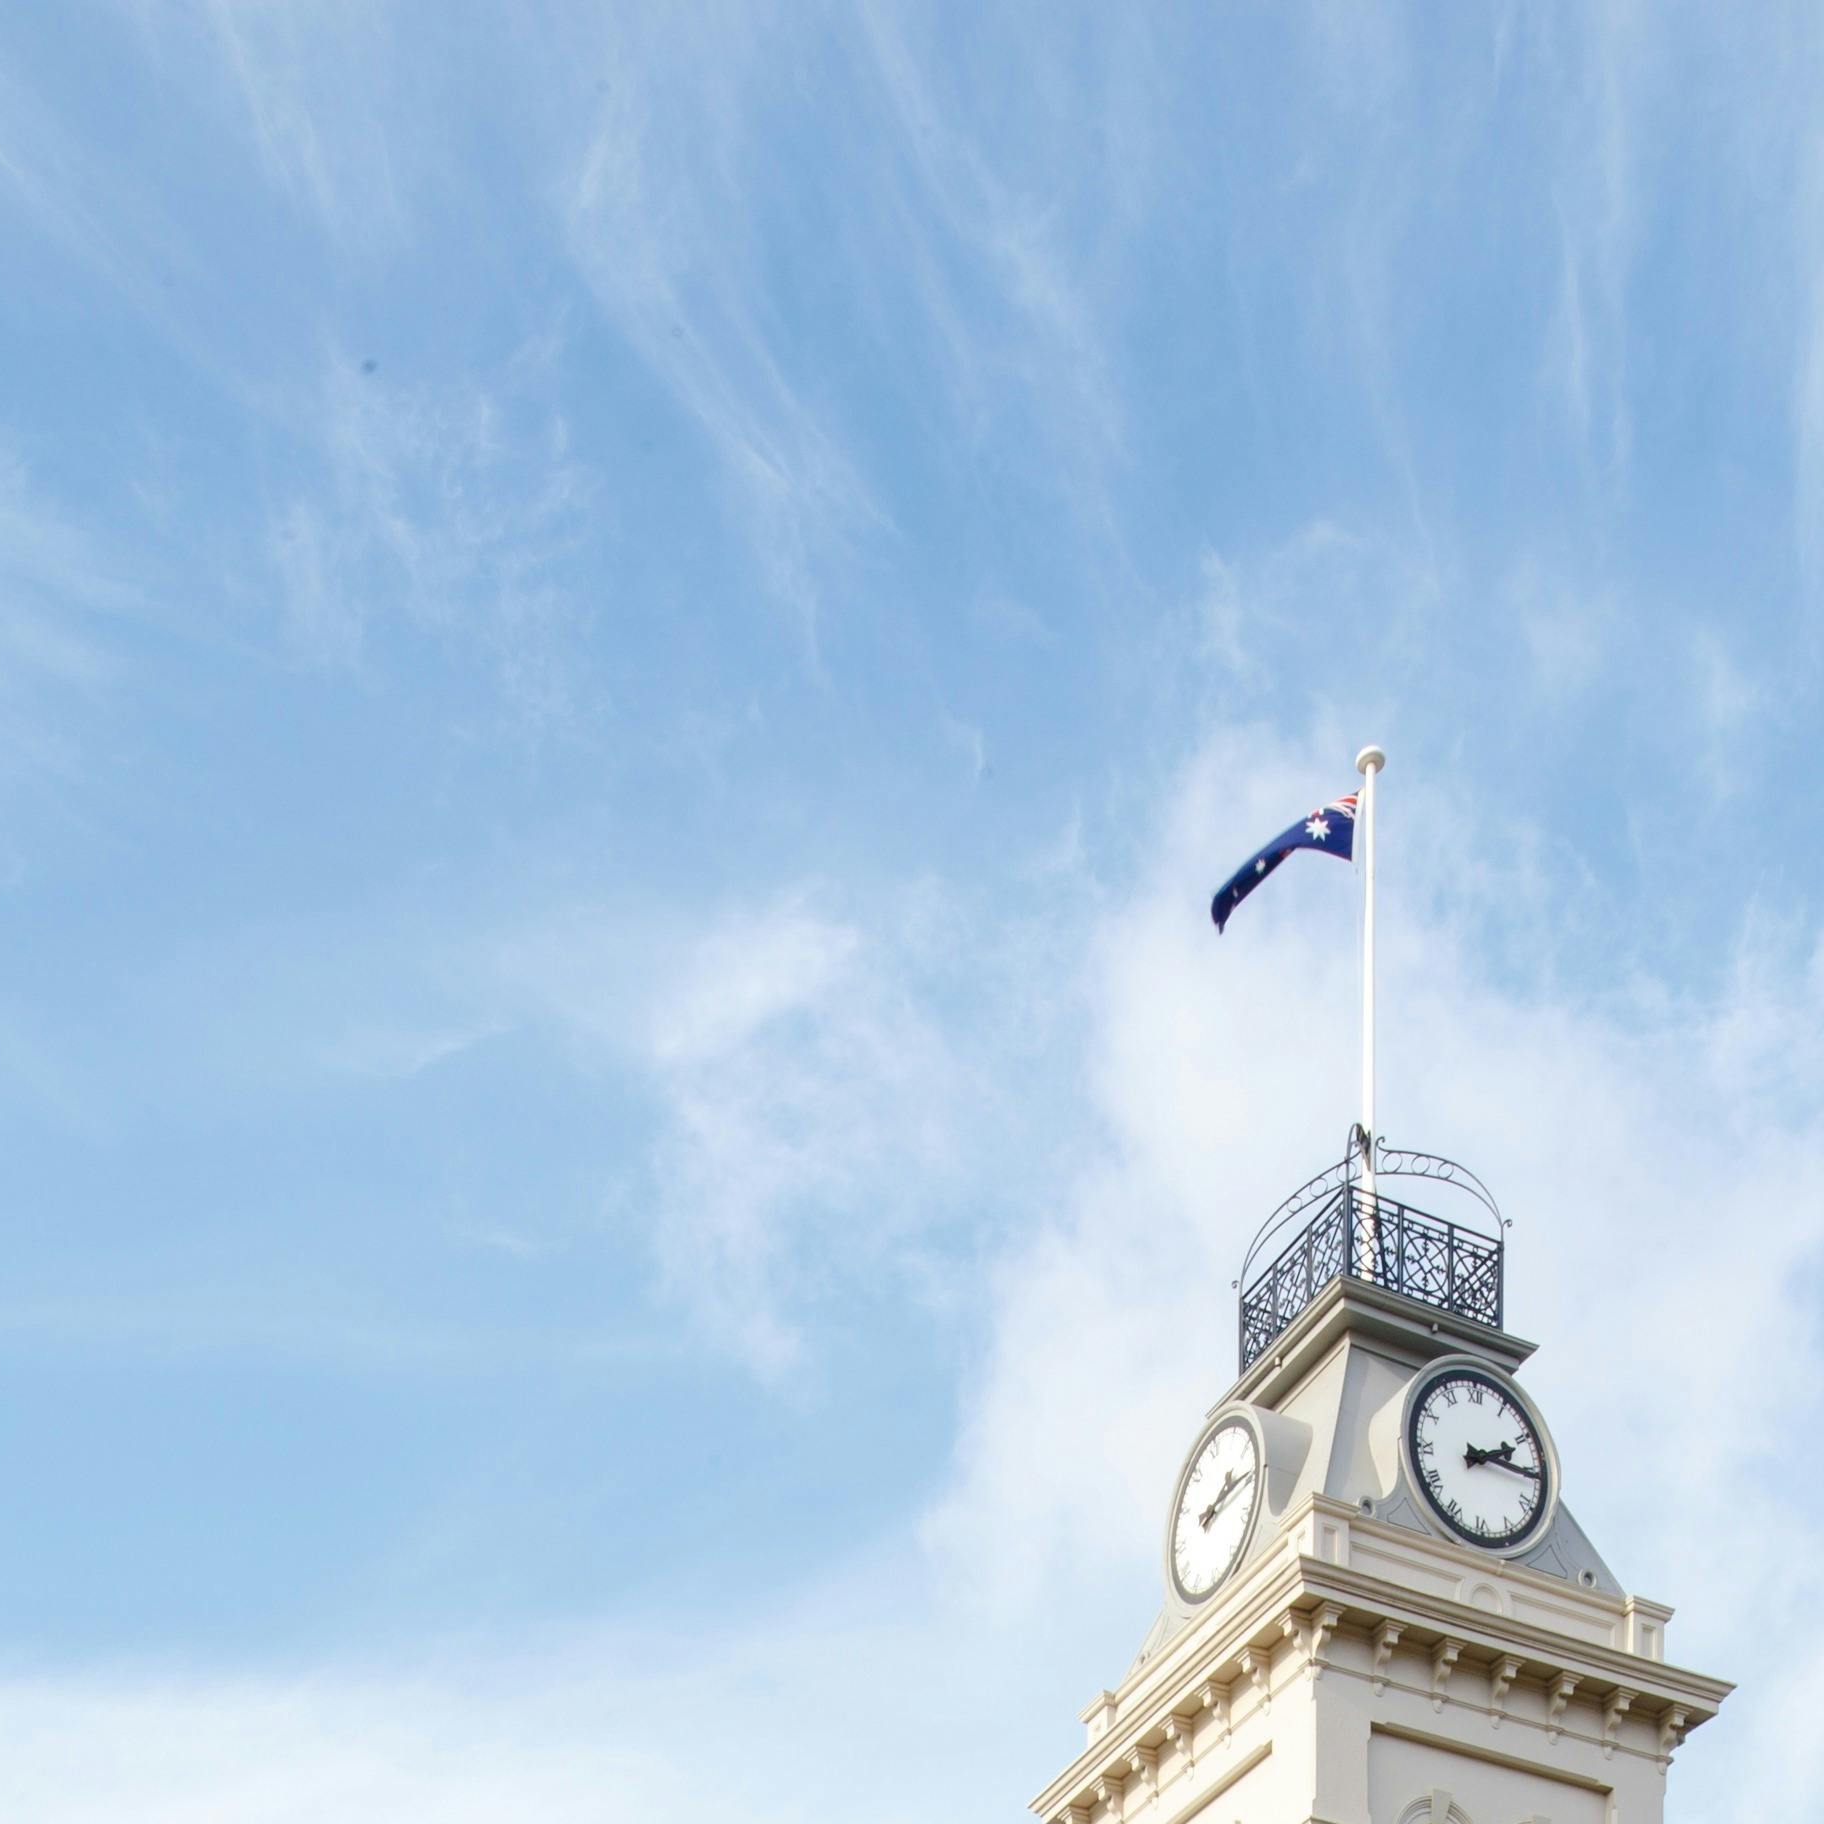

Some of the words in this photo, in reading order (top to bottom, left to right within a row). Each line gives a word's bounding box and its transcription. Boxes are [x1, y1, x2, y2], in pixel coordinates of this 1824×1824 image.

[1442, 1389, 1458, 1408] XI
[1466, 1388, 1484, 1405] XII
[1426, 1409, 1440, 1426] X
[1497, 1406, 1505, 1418] I
[1423, 1439, 1434, 1456] IX
[1514, 1434, 1526, 1445] II
[1475, 1516, 1491, 1532] VI
[1504, 1516, 1515, 1530] V
